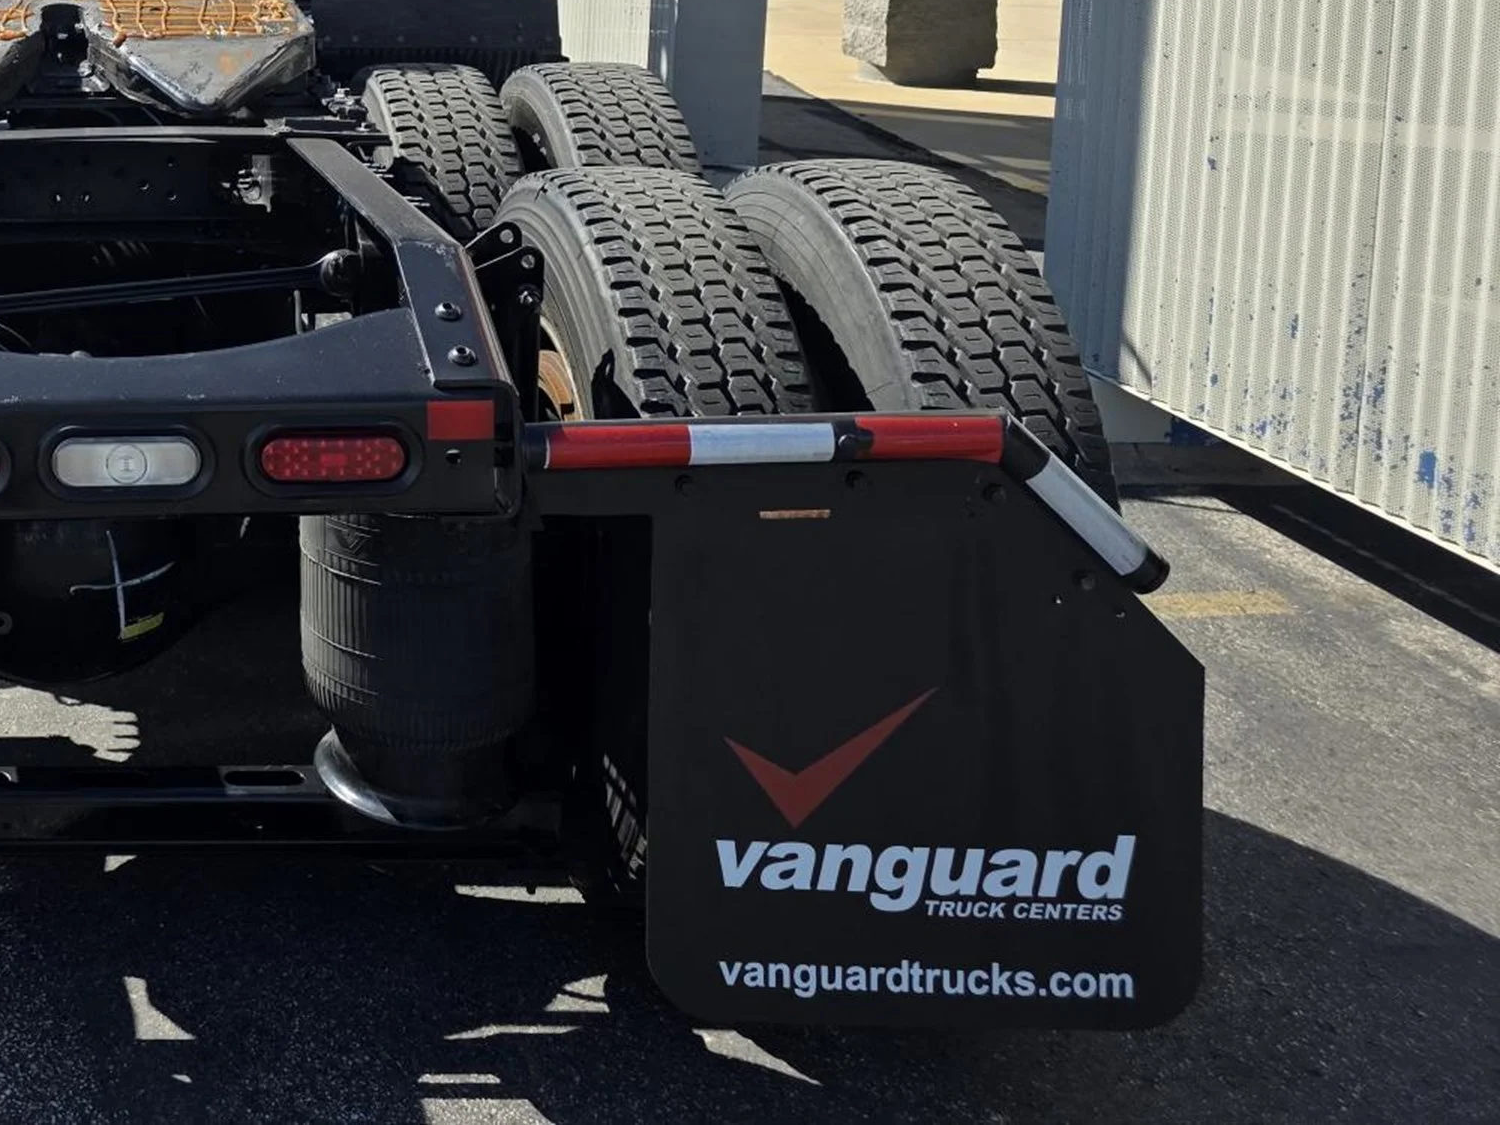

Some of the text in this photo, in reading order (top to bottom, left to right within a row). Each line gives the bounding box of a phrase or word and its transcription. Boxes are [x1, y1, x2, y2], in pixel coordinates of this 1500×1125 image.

[715, 835, 1136, 912] vanguard
[925, 900, 1123, 921] TRUCK CENTERS
[719, 960, 1134, 998] vanguardtrucks.com
